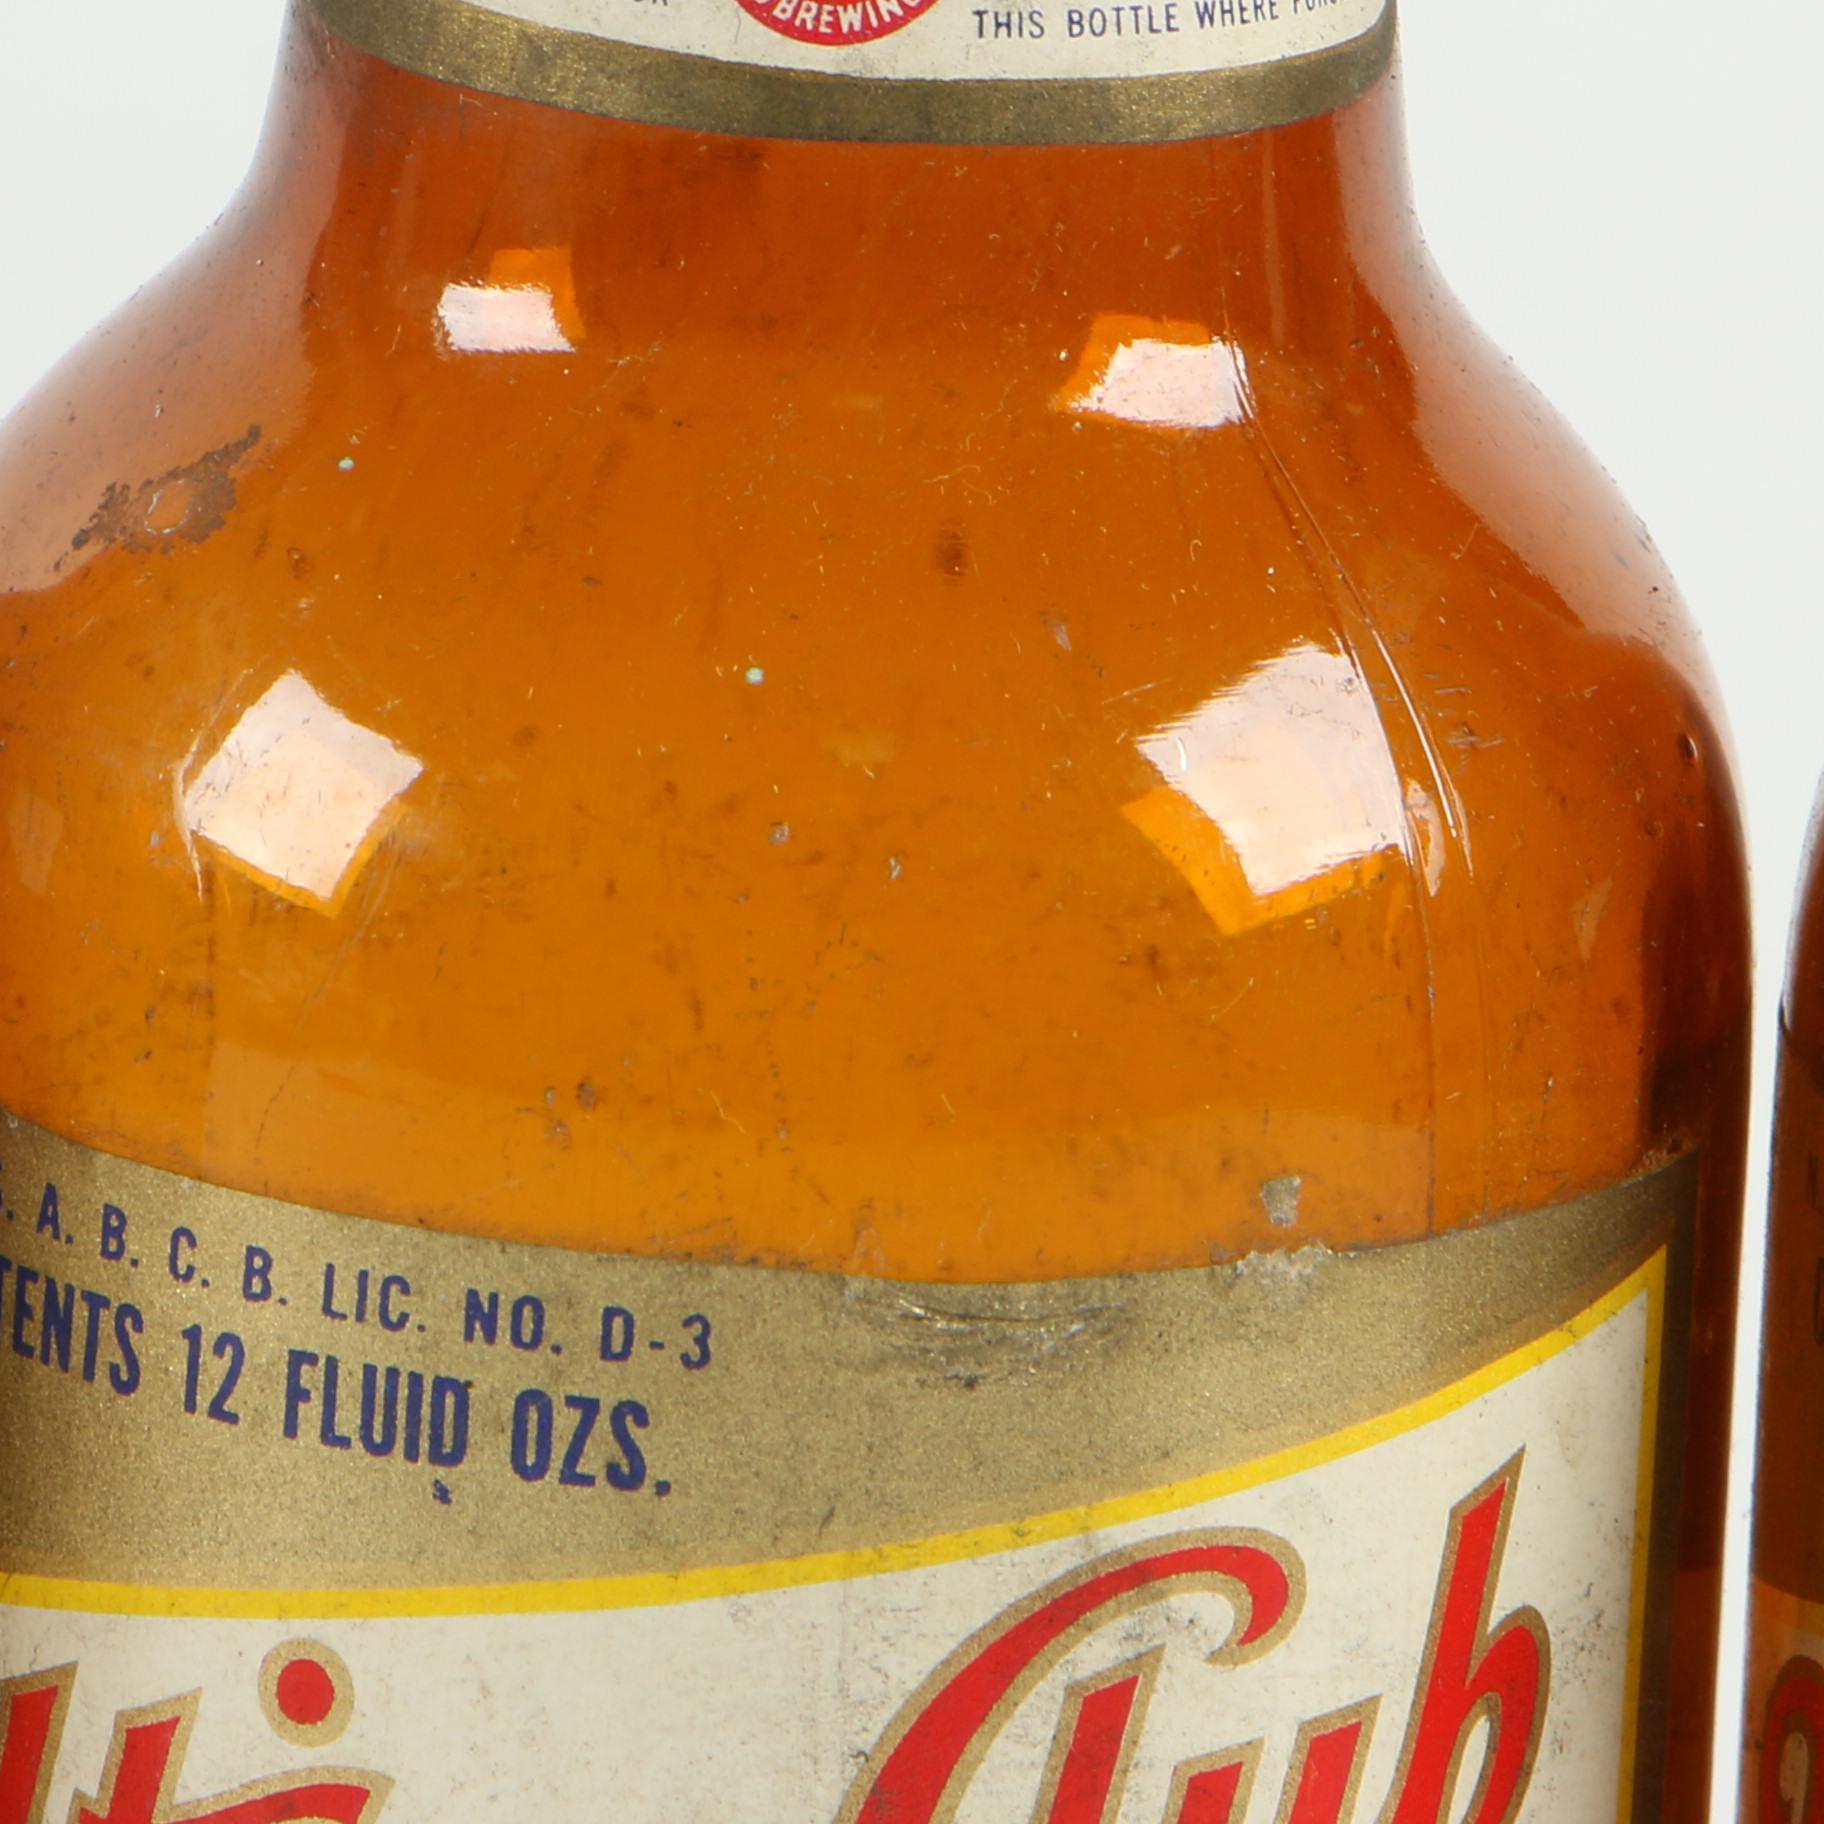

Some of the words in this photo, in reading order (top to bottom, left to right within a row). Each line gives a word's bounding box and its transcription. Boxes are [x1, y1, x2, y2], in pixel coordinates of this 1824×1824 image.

[973, 9, 1045, 39] THIS
[1068, 4, 1180, 38] BOTTLE
[321, 1261, 426, 1333] LIC.
[464, 1287, 562, 1355] NO.
[599, 1304, 713, 1370] D-3
[181, 1322, 245, 1425] 12
[283, 1348, 471, 1468] FLUID
[510, 1388, 672, 1497] OZS.
